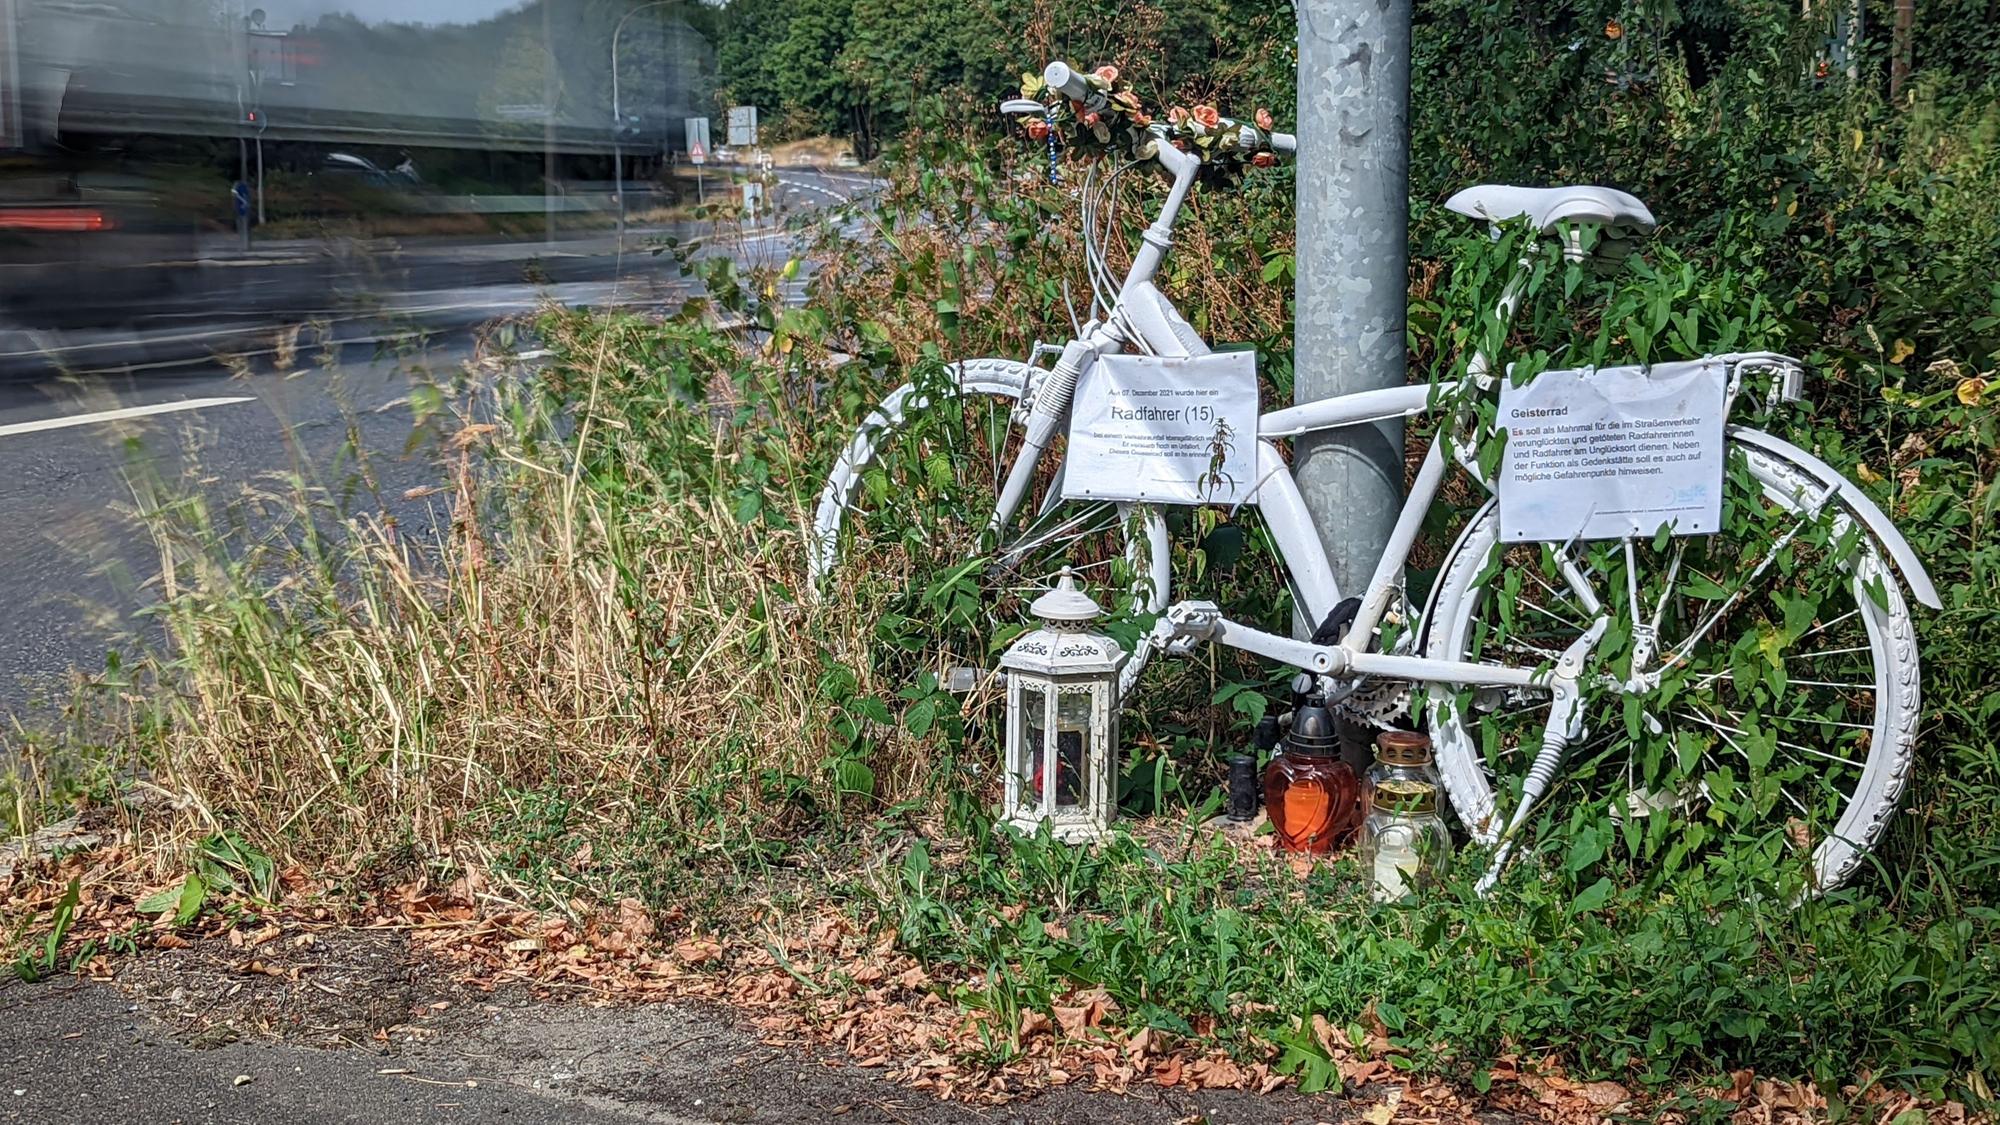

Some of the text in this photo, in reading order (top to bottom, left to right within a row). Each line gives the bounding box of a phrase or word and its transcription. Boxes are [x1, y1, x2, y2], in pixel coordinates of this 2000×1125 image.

[1132, 389, 1158, 397] Dezember
[1159, 389, 1174, 397] 2021
[1175, 389, 1195, 397] wurde
[1196, 389, 1208, 397] hier
[1111, 405, 1215, 424] Radfahrer (15)
[1511, 406, 1568, 418] Geisterrad
[1512, 418, 1701, 436] Es soll als Mahnmal für die im Straßenverkehr
[1513, 429, 1694, 448] verunglückten und getöteten Radfahrerinnen
[1513, 450, 1530, 459] und
[1532, 449, 1572, 458] Radfahrer
[1589, 445, 1636, 456] Unglücksort
[1638, 443, 1668, 452] dienen.
[1673, 441, 1700, 449] Neben
[1514, 461, 1528, 470] der
[1531, 459, 1565, 469] Funktion
[1567, 459, 1579, 467] als
[1581, 456, 1634, 467] Gedenkstätte
[1636, 454, 1651, 463] soll
[1665, 453, 1686, 461] auch
[1688, 451, 1701, 460] auf
[1514, 467, 1663, 483] mögliche Gefahrenpunkte hinweisen.
